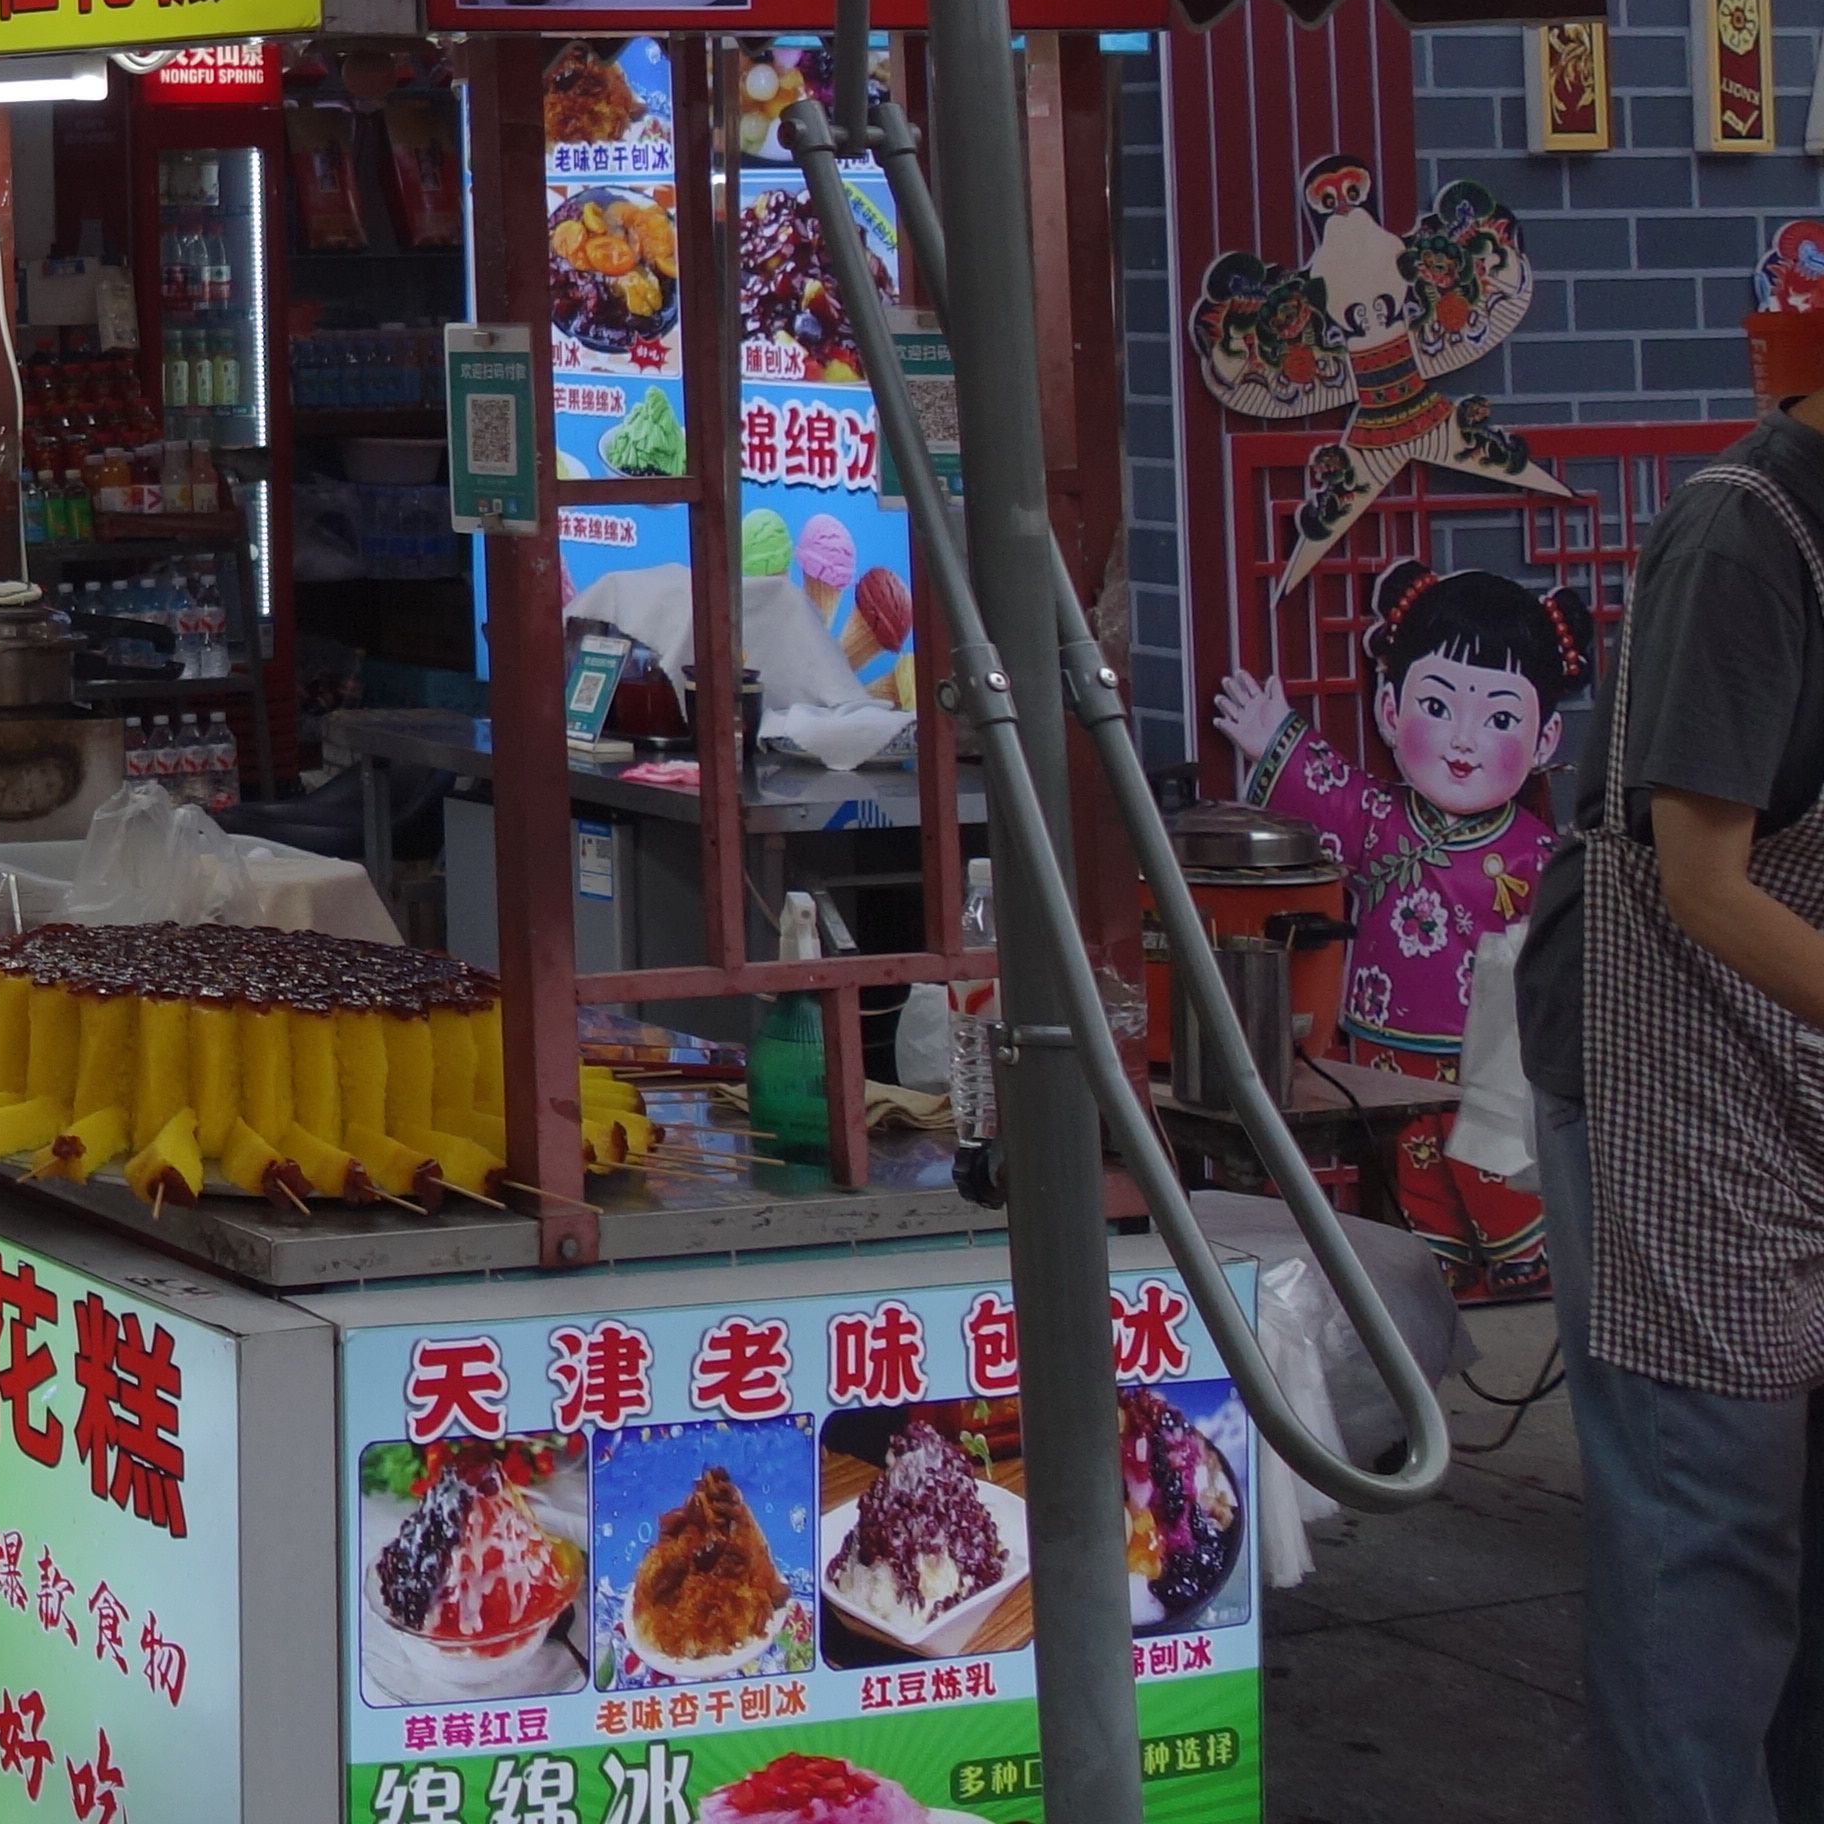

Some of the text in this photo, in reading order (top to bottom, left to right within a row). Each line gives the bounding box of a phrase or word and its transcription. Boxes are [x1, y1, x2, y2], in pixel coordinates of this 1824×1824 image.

[160, 67, 265, 85] NONGFU SPRING
[554, 142, 670, 172] 老味杏干刨冰
[460, 360, 527, 382] 欢迎扫码付款
[859, 1663, 997, 1712] 红豆炼乳
[403, 1707, 550, 1752] 草莓红豆
[595, 1687, 807, 1736] 老味杏干刨冰
[372, 1741, 696, 1824] 绵绵冰
